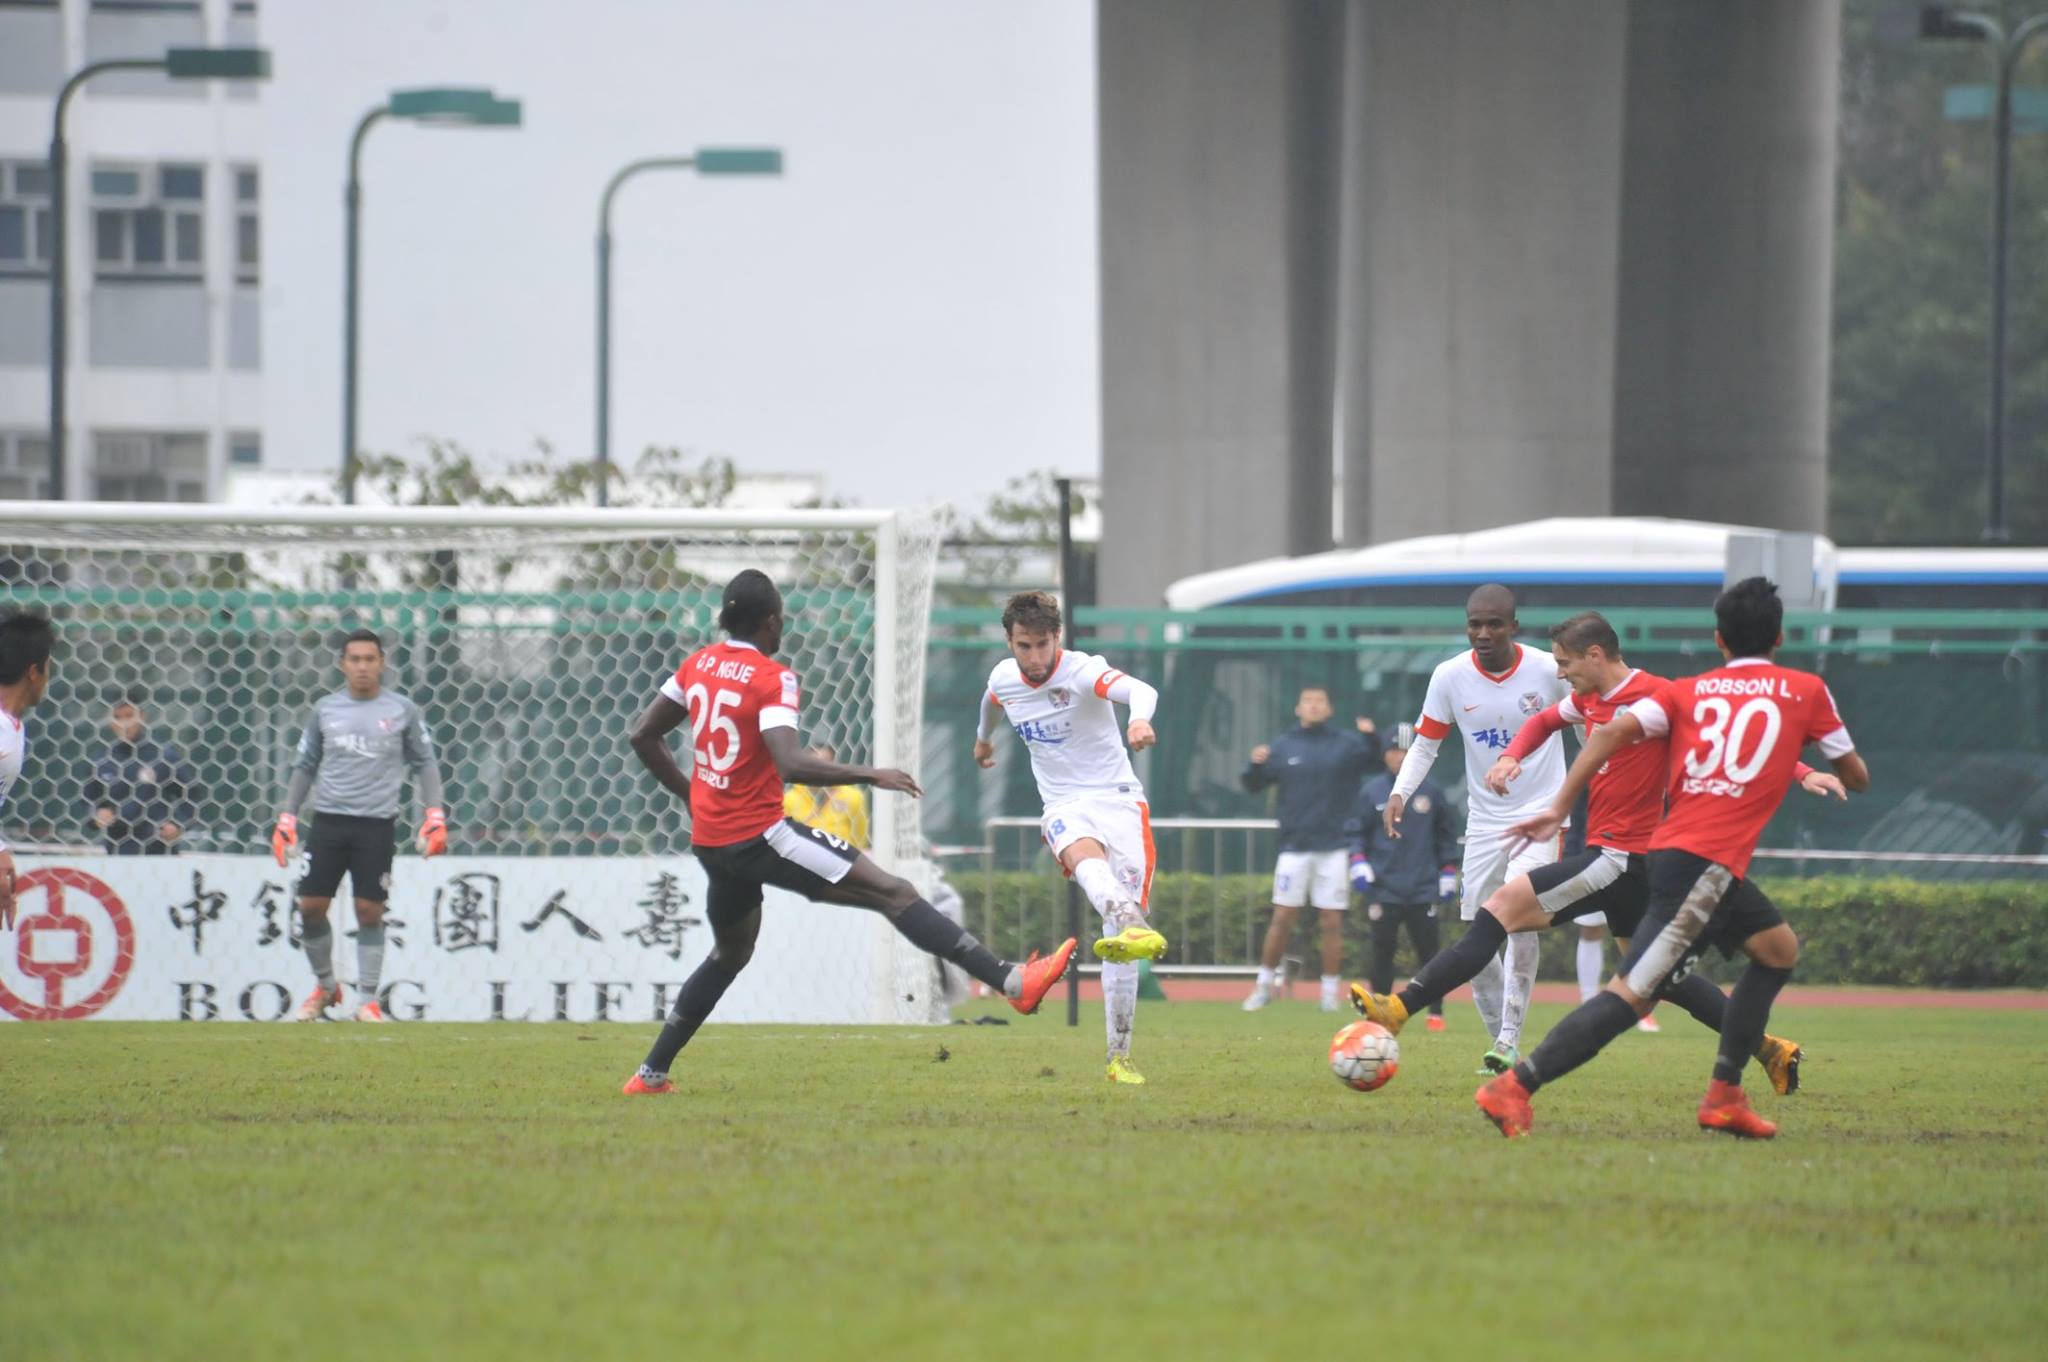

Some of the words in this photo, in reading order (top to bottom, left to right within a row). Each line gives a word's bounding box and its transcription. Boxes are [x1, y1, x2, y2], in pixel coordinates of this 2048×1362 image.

[686, 683, 742, 772] 25
[1695, 677, 1775, 696] ROBSON
[1684, 697, 1782, 784] 30
